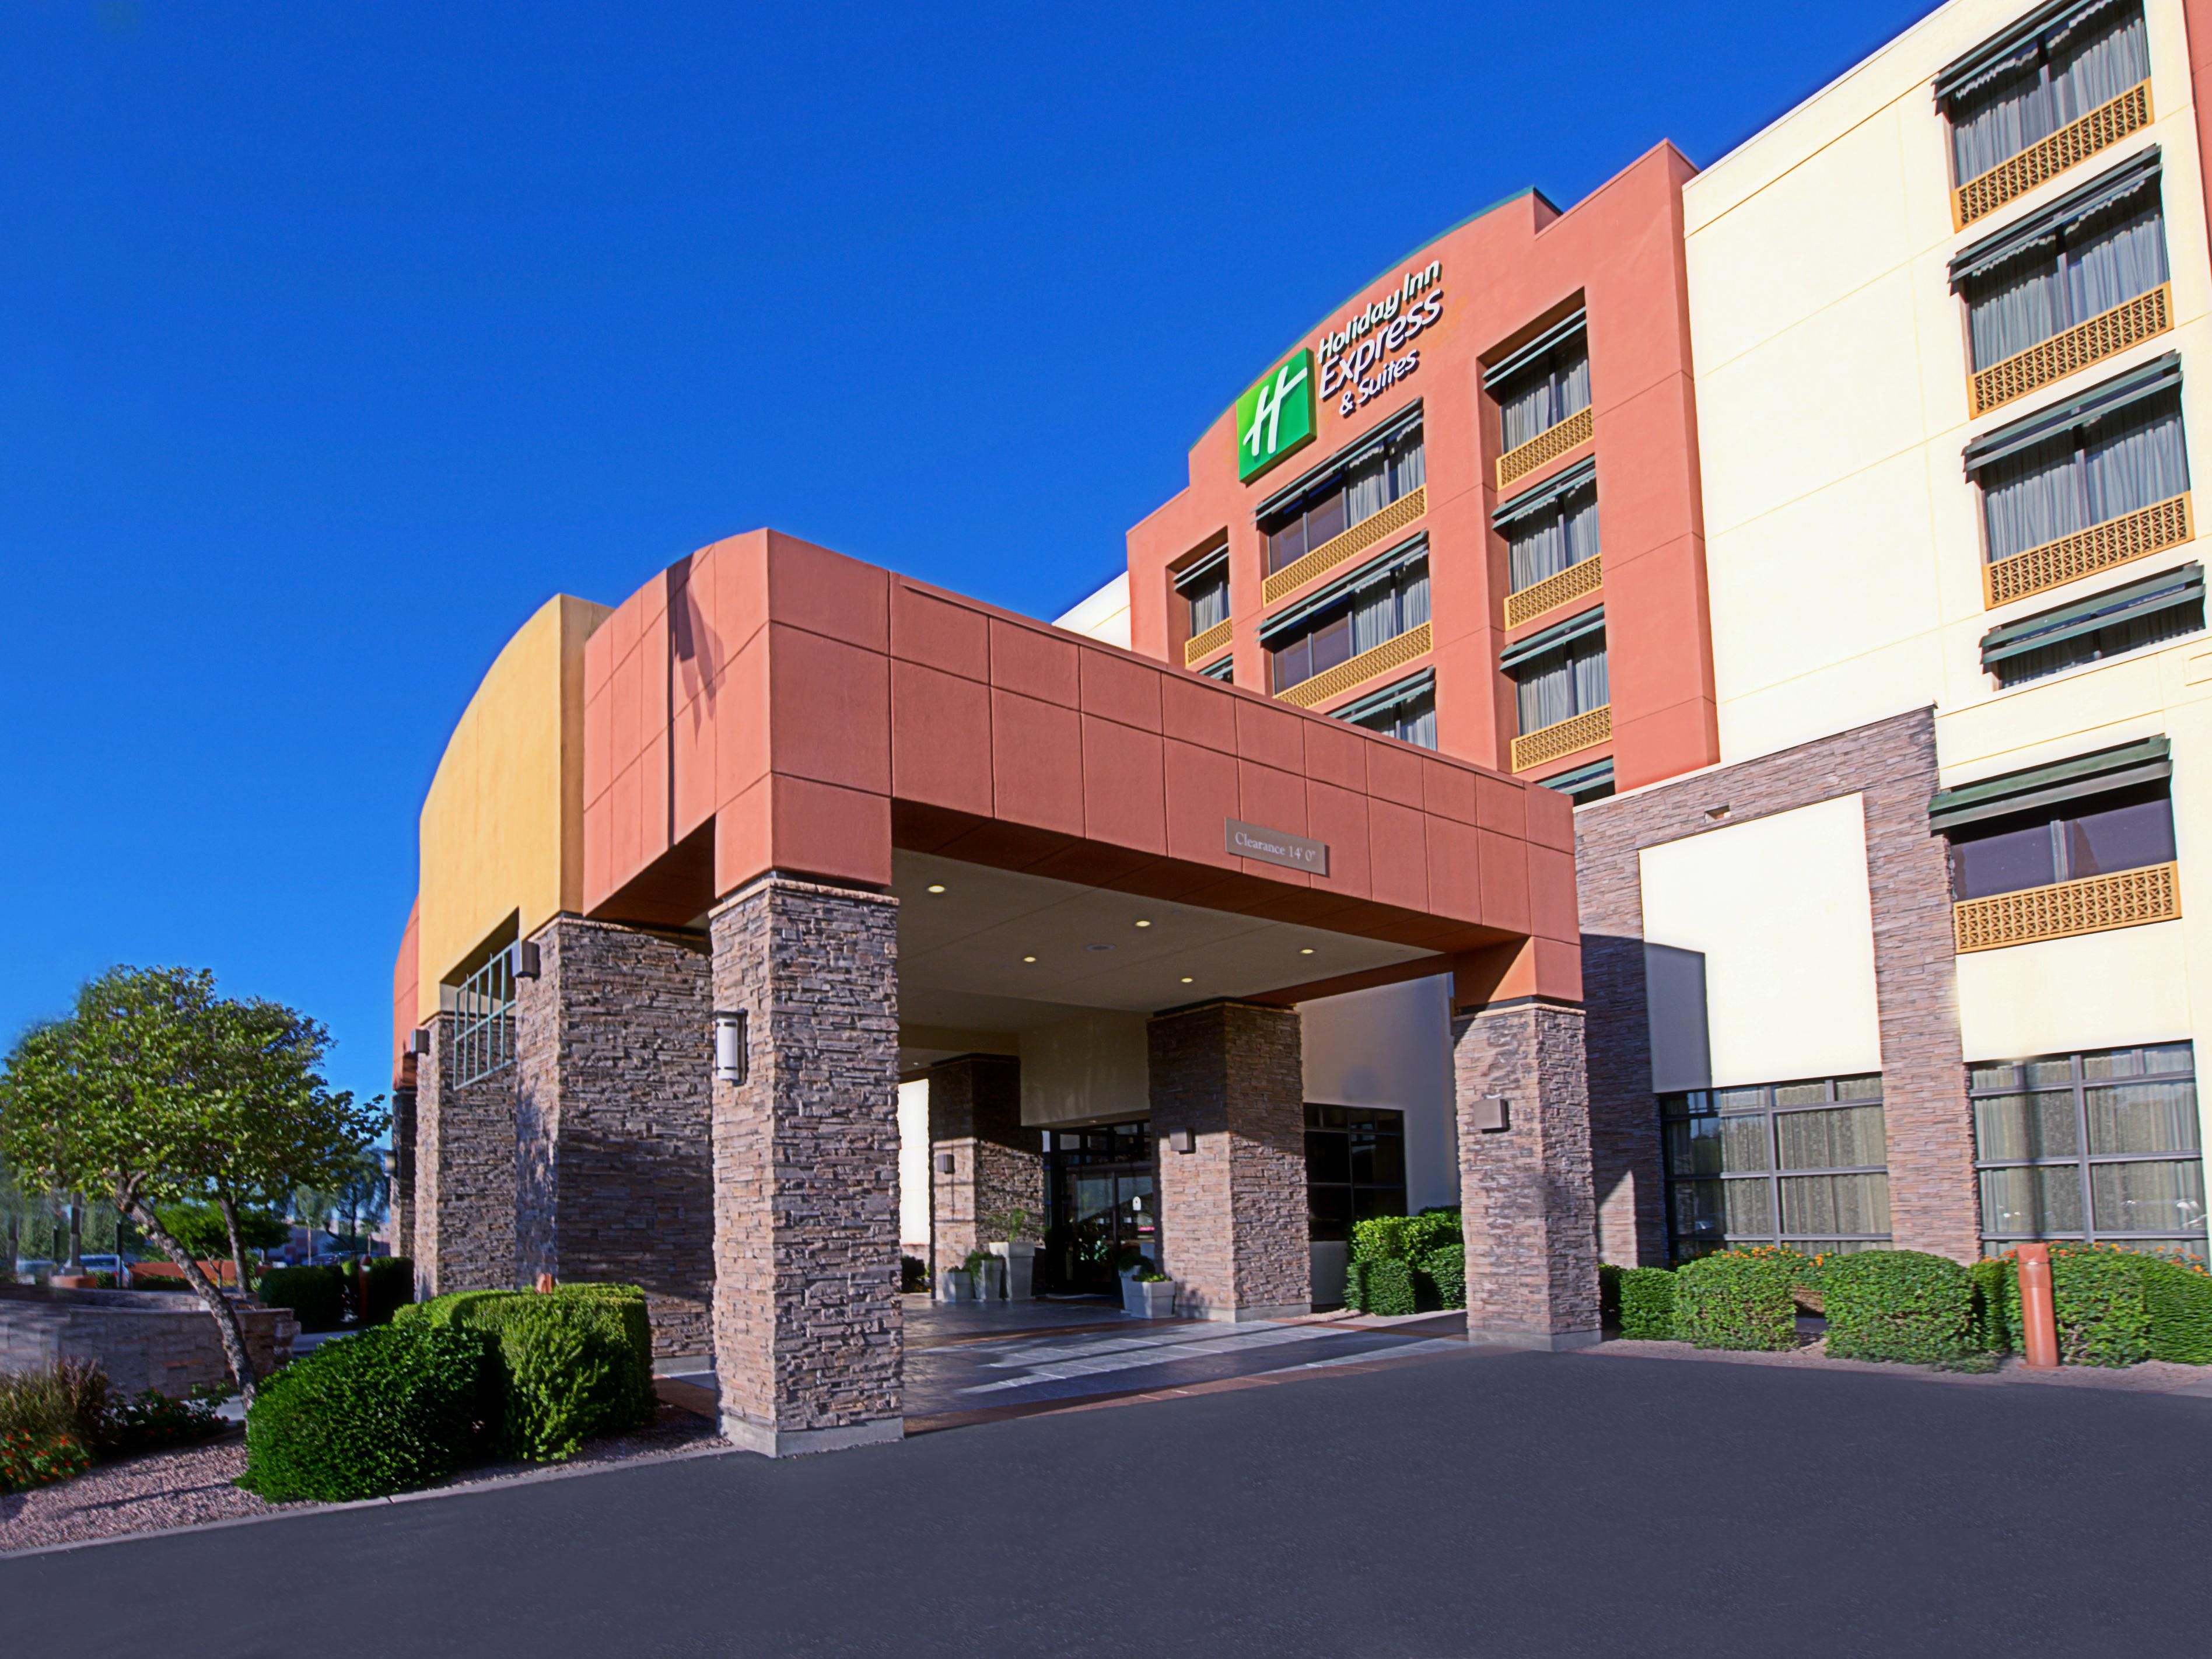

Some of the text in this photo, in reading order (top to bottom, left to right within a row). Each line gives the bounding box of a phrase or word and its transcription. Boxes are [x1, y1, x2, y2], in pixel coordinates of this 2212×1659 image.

[1317, 260, 1440, 363] Holiday Inn
[1319, 289, 1441, 398] Express
[1339, 349, 1417, 415] & Suites
[1235, 831, 1286, 855] Clearance
[1289, 846, 1302, 859] 14'
